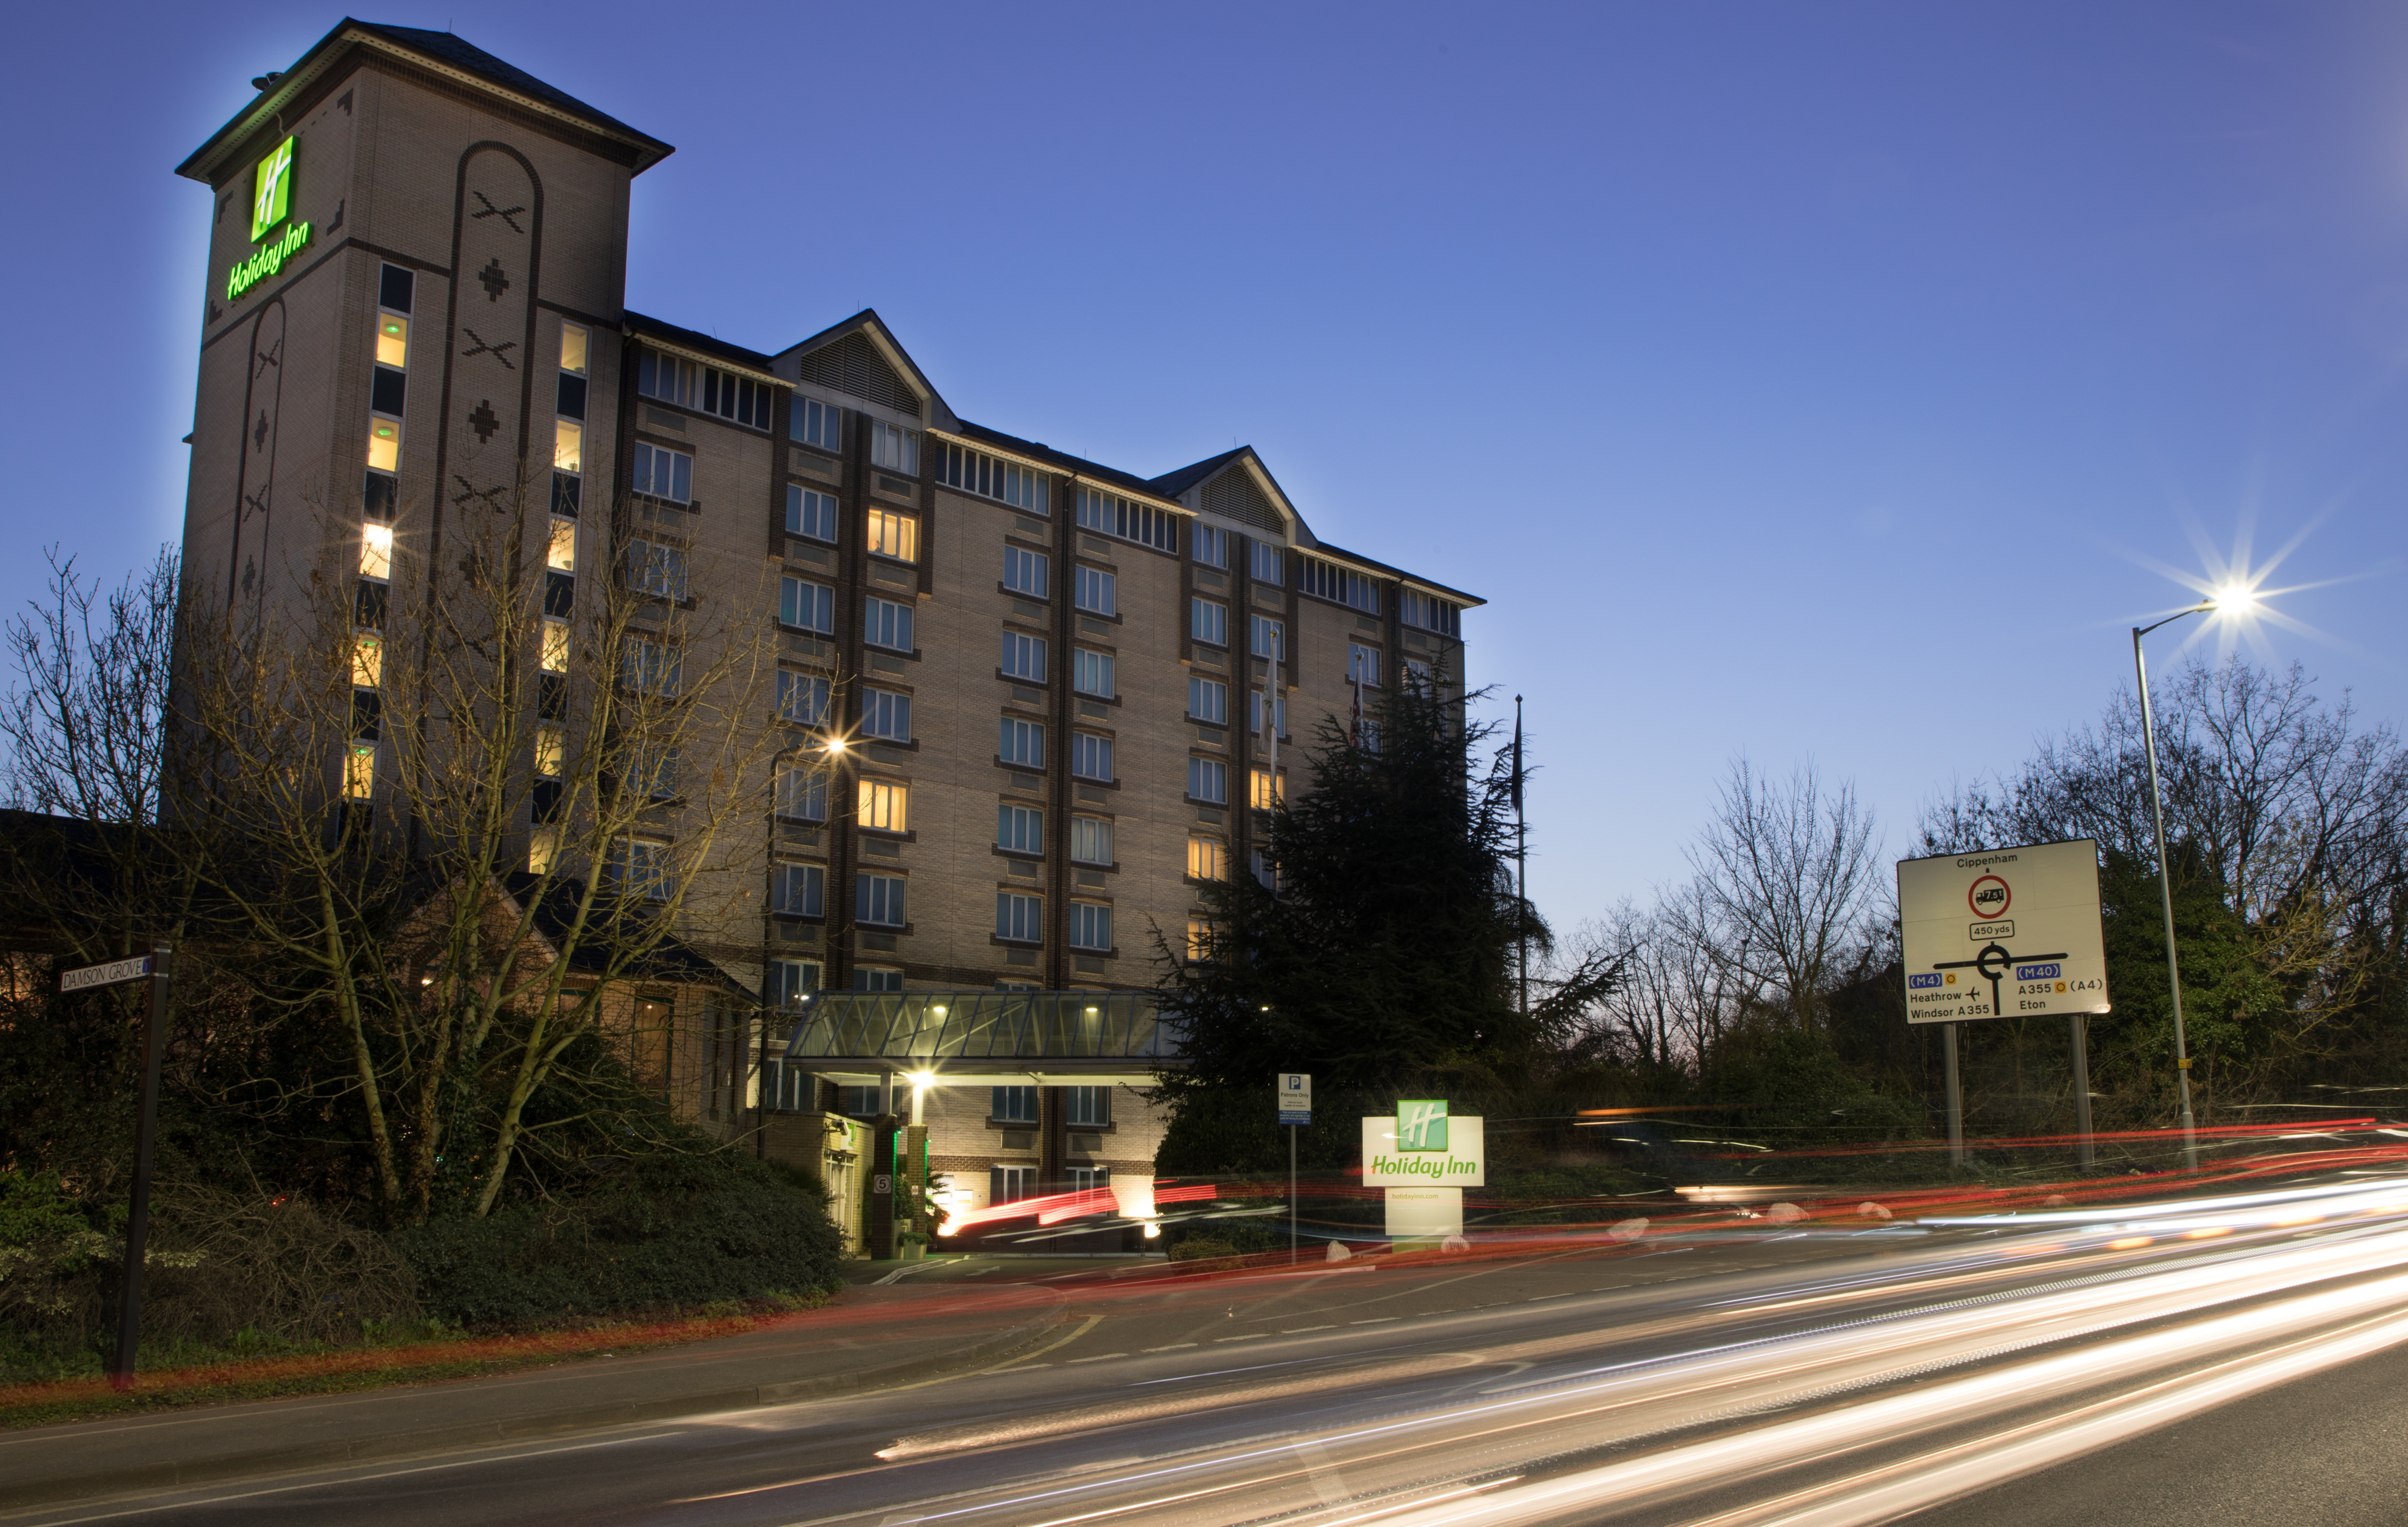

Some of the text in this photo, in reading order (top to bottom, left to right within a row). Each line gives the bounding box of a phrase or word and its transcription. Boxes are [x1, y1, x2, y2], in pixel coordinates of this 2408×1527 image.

[227, 221, 308, 300] Holiday Inn
[1957, 854, 2018, 868] Cippenham
[1974, 925, 2010, 935] 450 yds
[63, 959, 142, 988] DAMSON GROVE
[2017, 964, 2059, 979] (M40)
[1909, 975, 1941, 988] (M4)
[2018, 979, 2103, 995] A355 (A4)
[1910, 992, 1962, 1003] Heathrow
[1911, 1004, 1989, 1019] Windsor A355
[2019, 1000, 2046, 1010] Eton
[1371, 1155, 1476, 1179] Holiday Inn
[878, 1179, 886, 1189] 5
